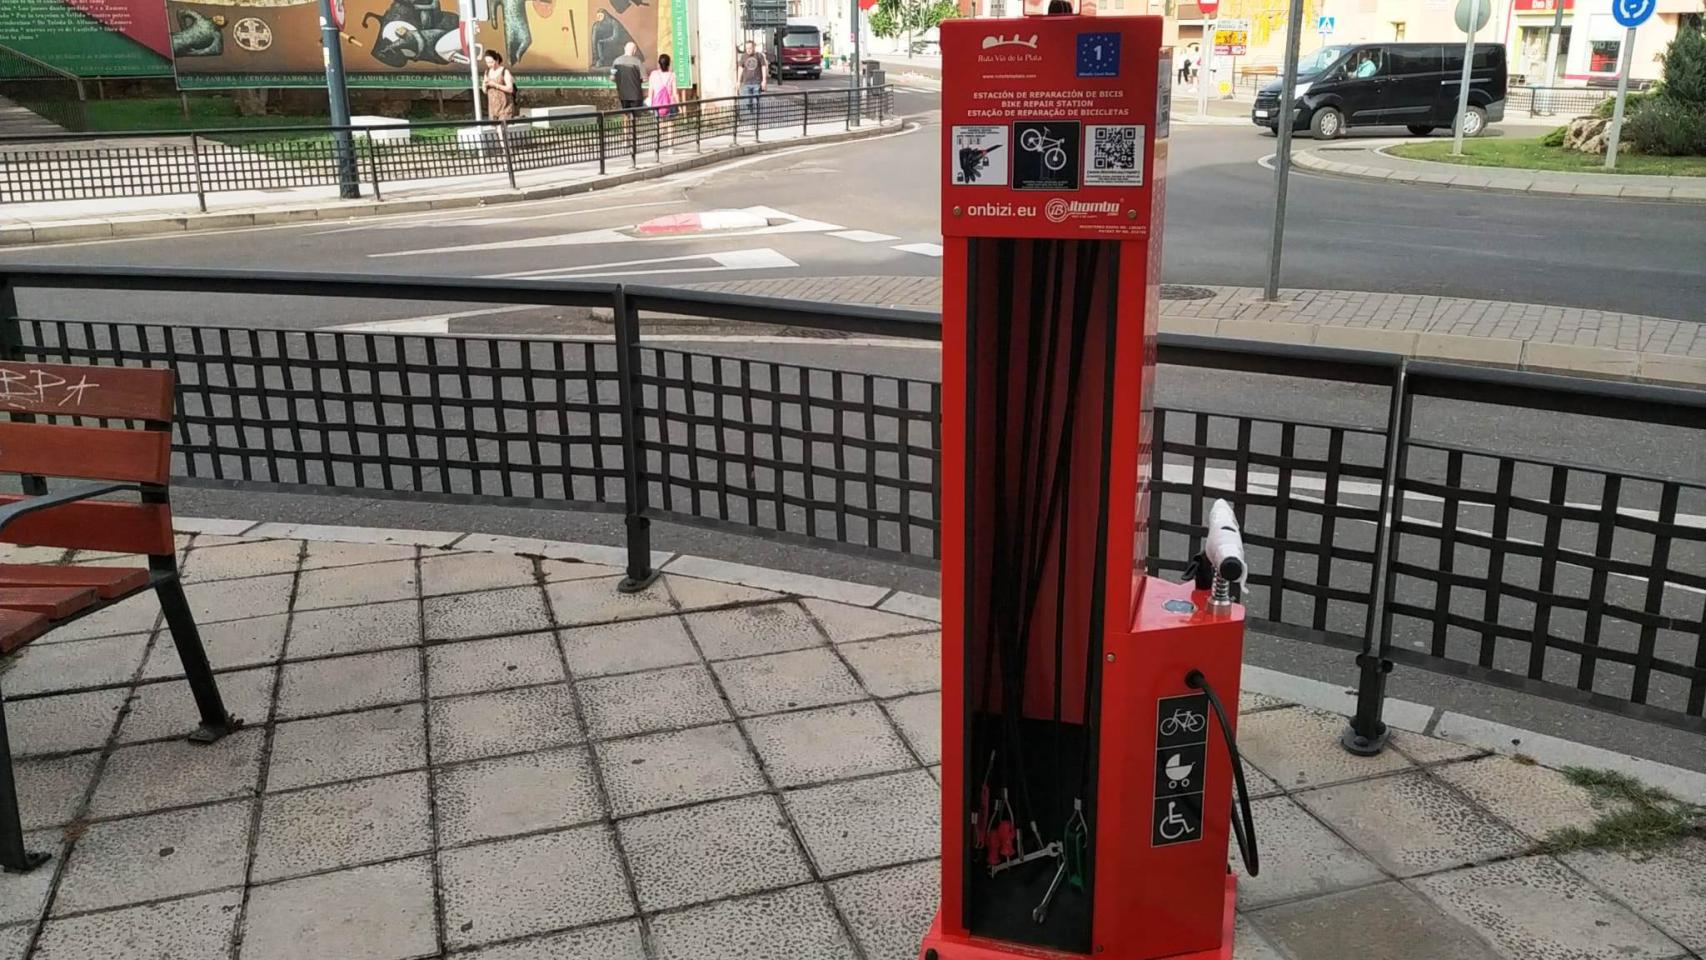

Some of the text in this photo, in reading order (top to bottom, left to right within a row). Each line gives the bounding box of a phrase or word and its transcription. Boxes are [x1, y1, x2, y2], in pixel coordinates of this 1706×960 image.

[1093, 45, 1102, 61] 1
[977, 54, 993, 62] Ruta
[973, 91, 1014, 99] ESTACIÓN
[1029, 89, 1083, 98] REPARACIÓN
[1001, 100, 1021, 108] BIKE
[968, 108, 1003, 117] ESTAÇÃO
[1017, 108, 1065, 117] REPARAÇÃO
[1080, 108, 1129, 116] BICICLETAS
[968, 202, 1036, 216] onbizi.eu
